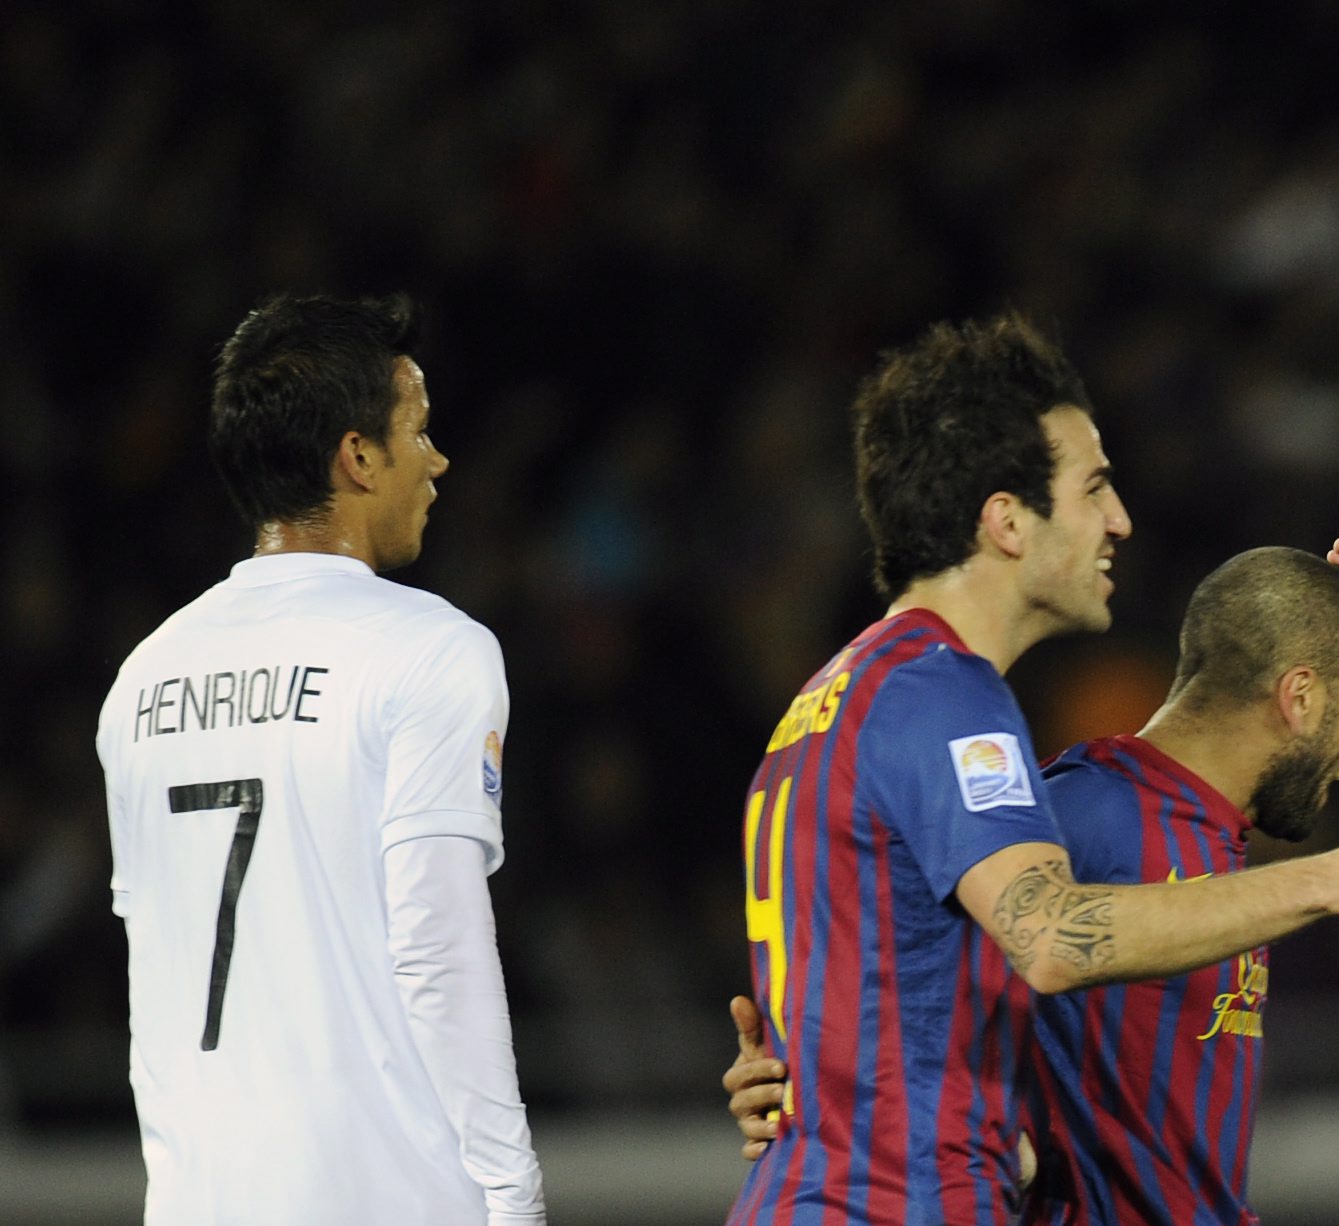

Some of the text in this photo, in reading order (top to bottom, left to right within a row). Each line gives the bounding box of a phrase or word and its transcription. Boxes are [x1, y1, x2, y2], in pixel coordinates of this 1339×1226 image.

[134, 665, 329, 743] HENRIQUE
[168, 777, 264, 1052] 7
[744, 775, 793, 1044] 4
